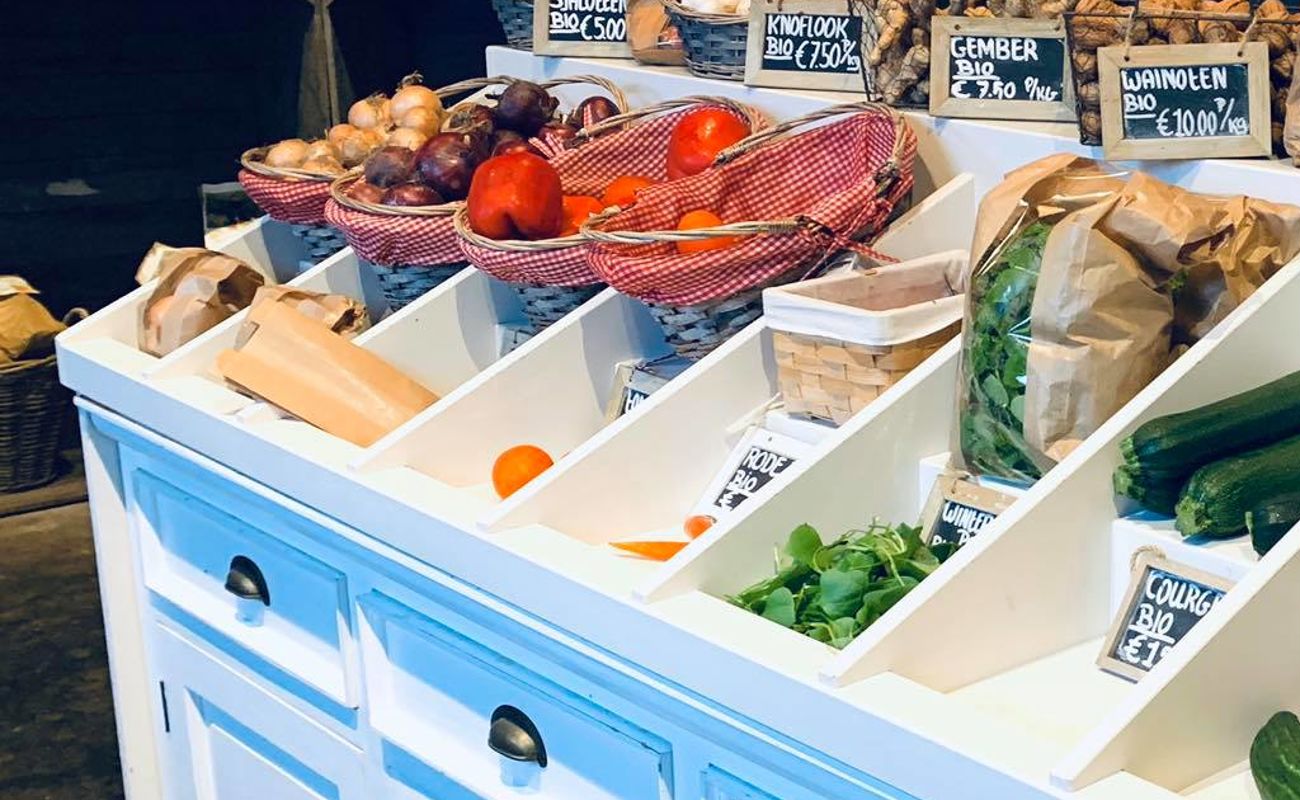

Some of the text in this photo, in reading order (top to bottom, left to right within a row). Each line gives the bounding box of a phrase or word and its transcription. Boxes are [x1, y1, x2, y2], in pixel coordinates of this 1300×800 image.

[550, 11, 579, 29] BIO
[767, 14, 849, 39] KNOFLOOK
[765, 36, 794, 56] BIO
[950, 36, 1038, 62] GEMBER
[955, 59, 994, 76] BIO
[1123, 93, 1157, 112] BIO
[742, 448, 787, 477] RODE
[1135, 603, 1174, 635] BIO
